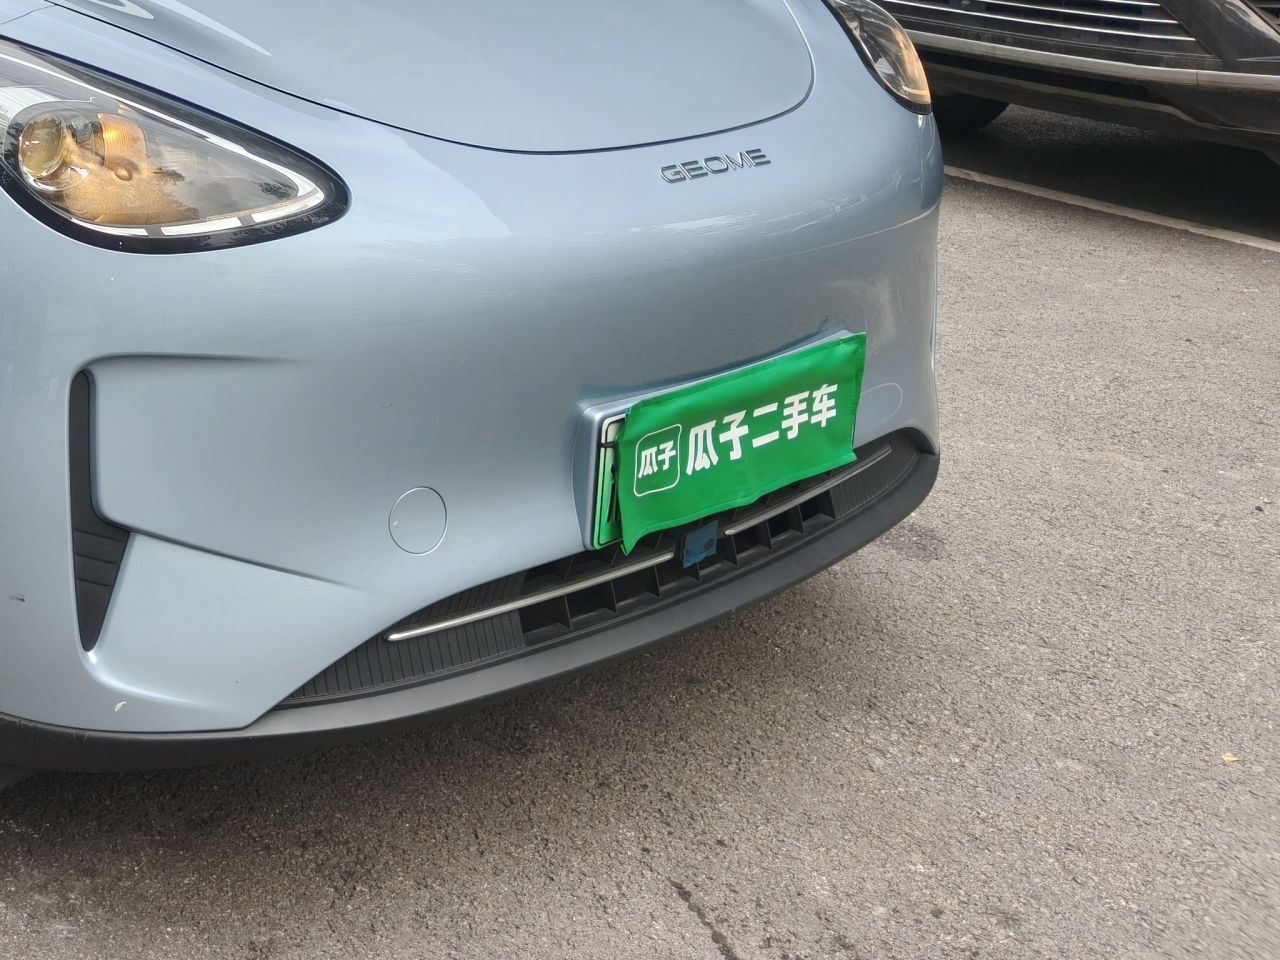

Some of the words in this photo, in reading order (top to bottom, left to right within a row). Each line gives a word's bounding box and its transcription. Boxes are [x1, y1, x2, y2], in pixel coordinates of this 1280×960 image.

[660, 148, 771, 184] GEOME
[638, 440, 677, 479] 瓜子
[686, 383, 838, 476] 瓜子二手车
